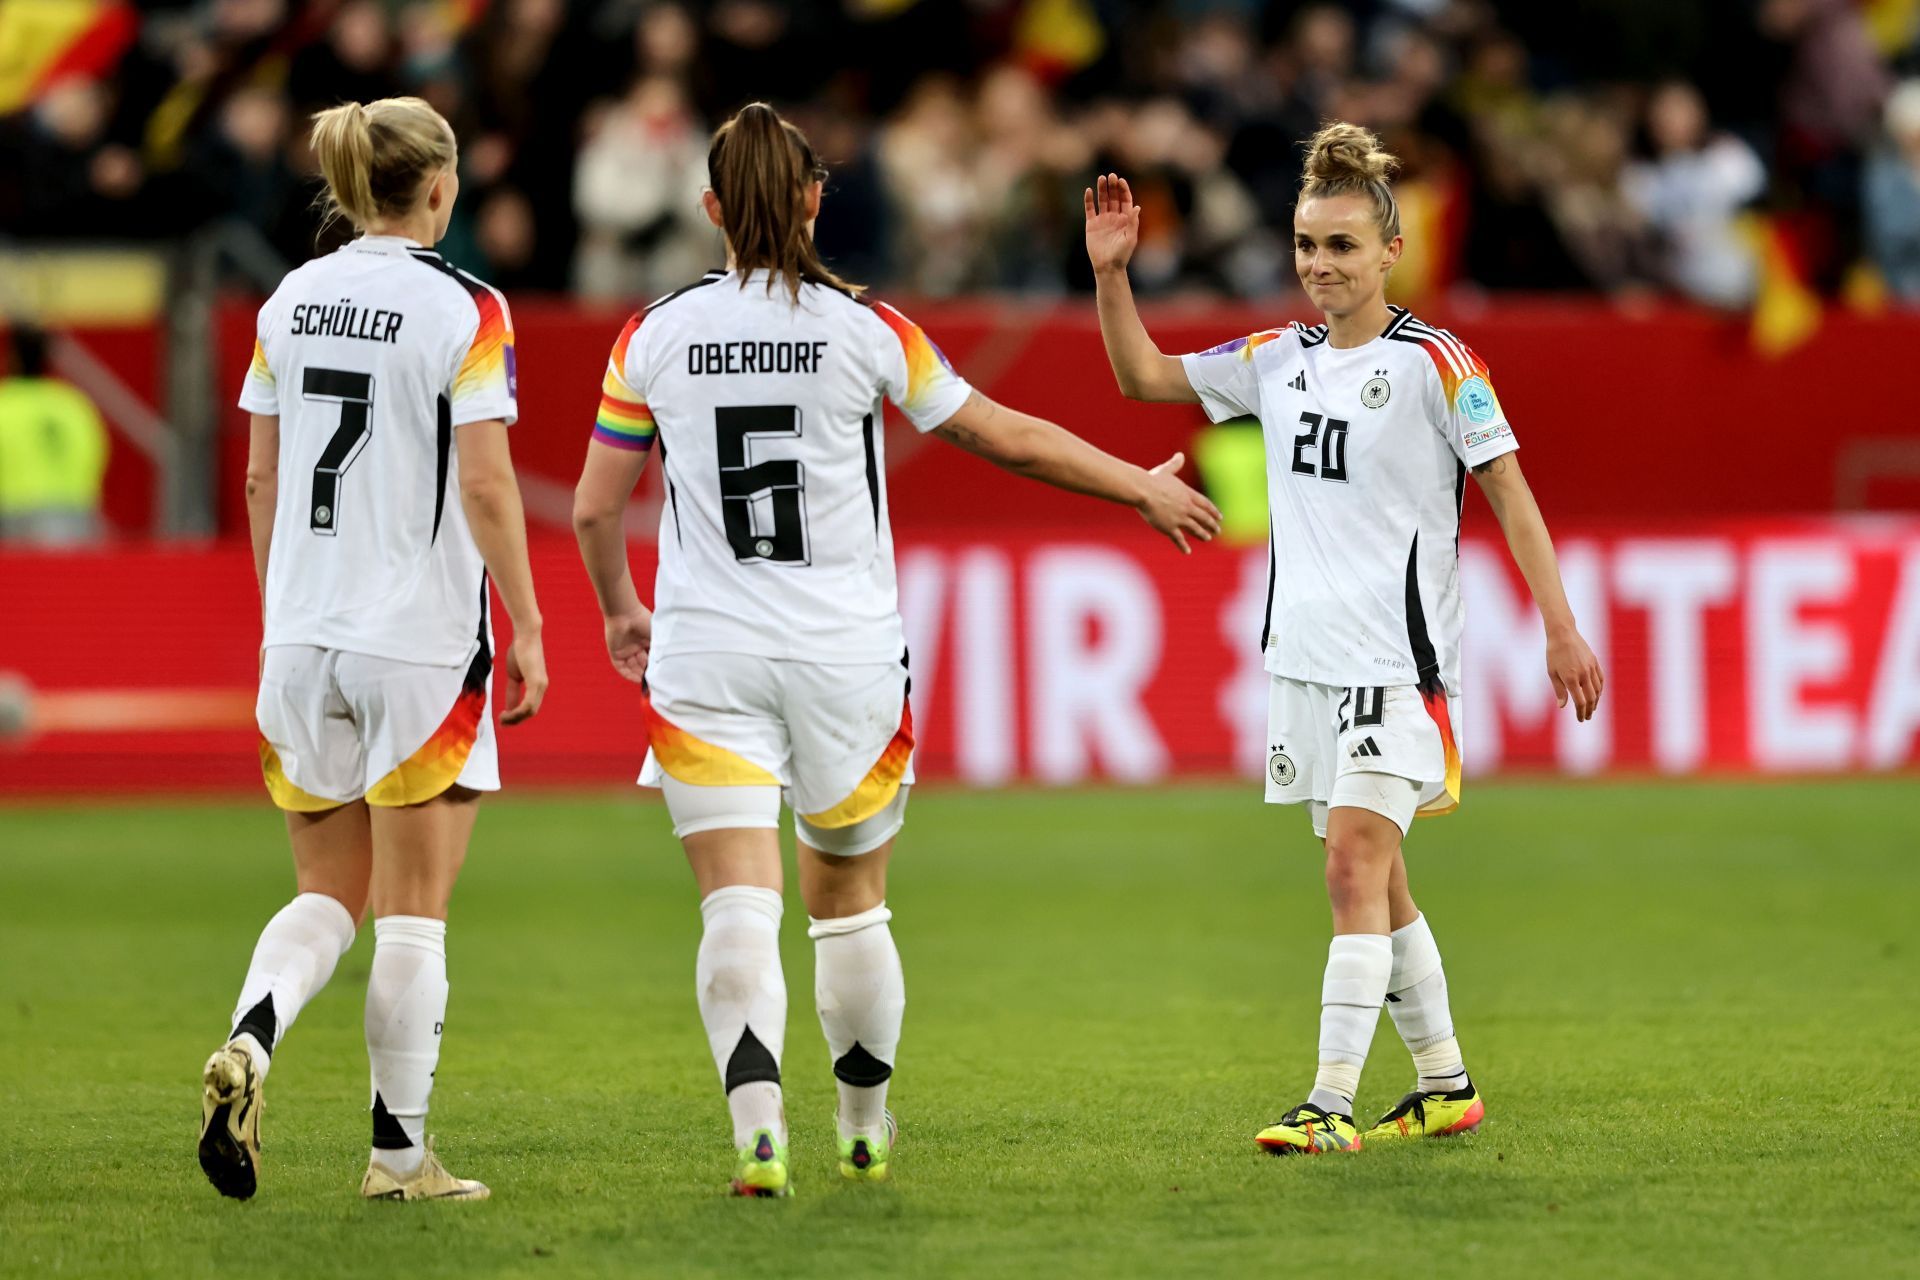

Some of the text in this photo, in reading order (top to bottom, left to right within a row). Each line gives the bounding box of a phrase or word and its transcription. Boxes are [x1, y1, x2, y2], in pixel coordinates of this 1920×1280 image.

[290, 297, 404, 344] SCHÜLLER
[688, 341, 828, 375] OBERDORF
[302, 366, 376, 537] 7
[1291, 411, 1351, 484] 20
[1464, 424, 1511, 446] FOUNDATION
[715, 405, 812, 567] 6
